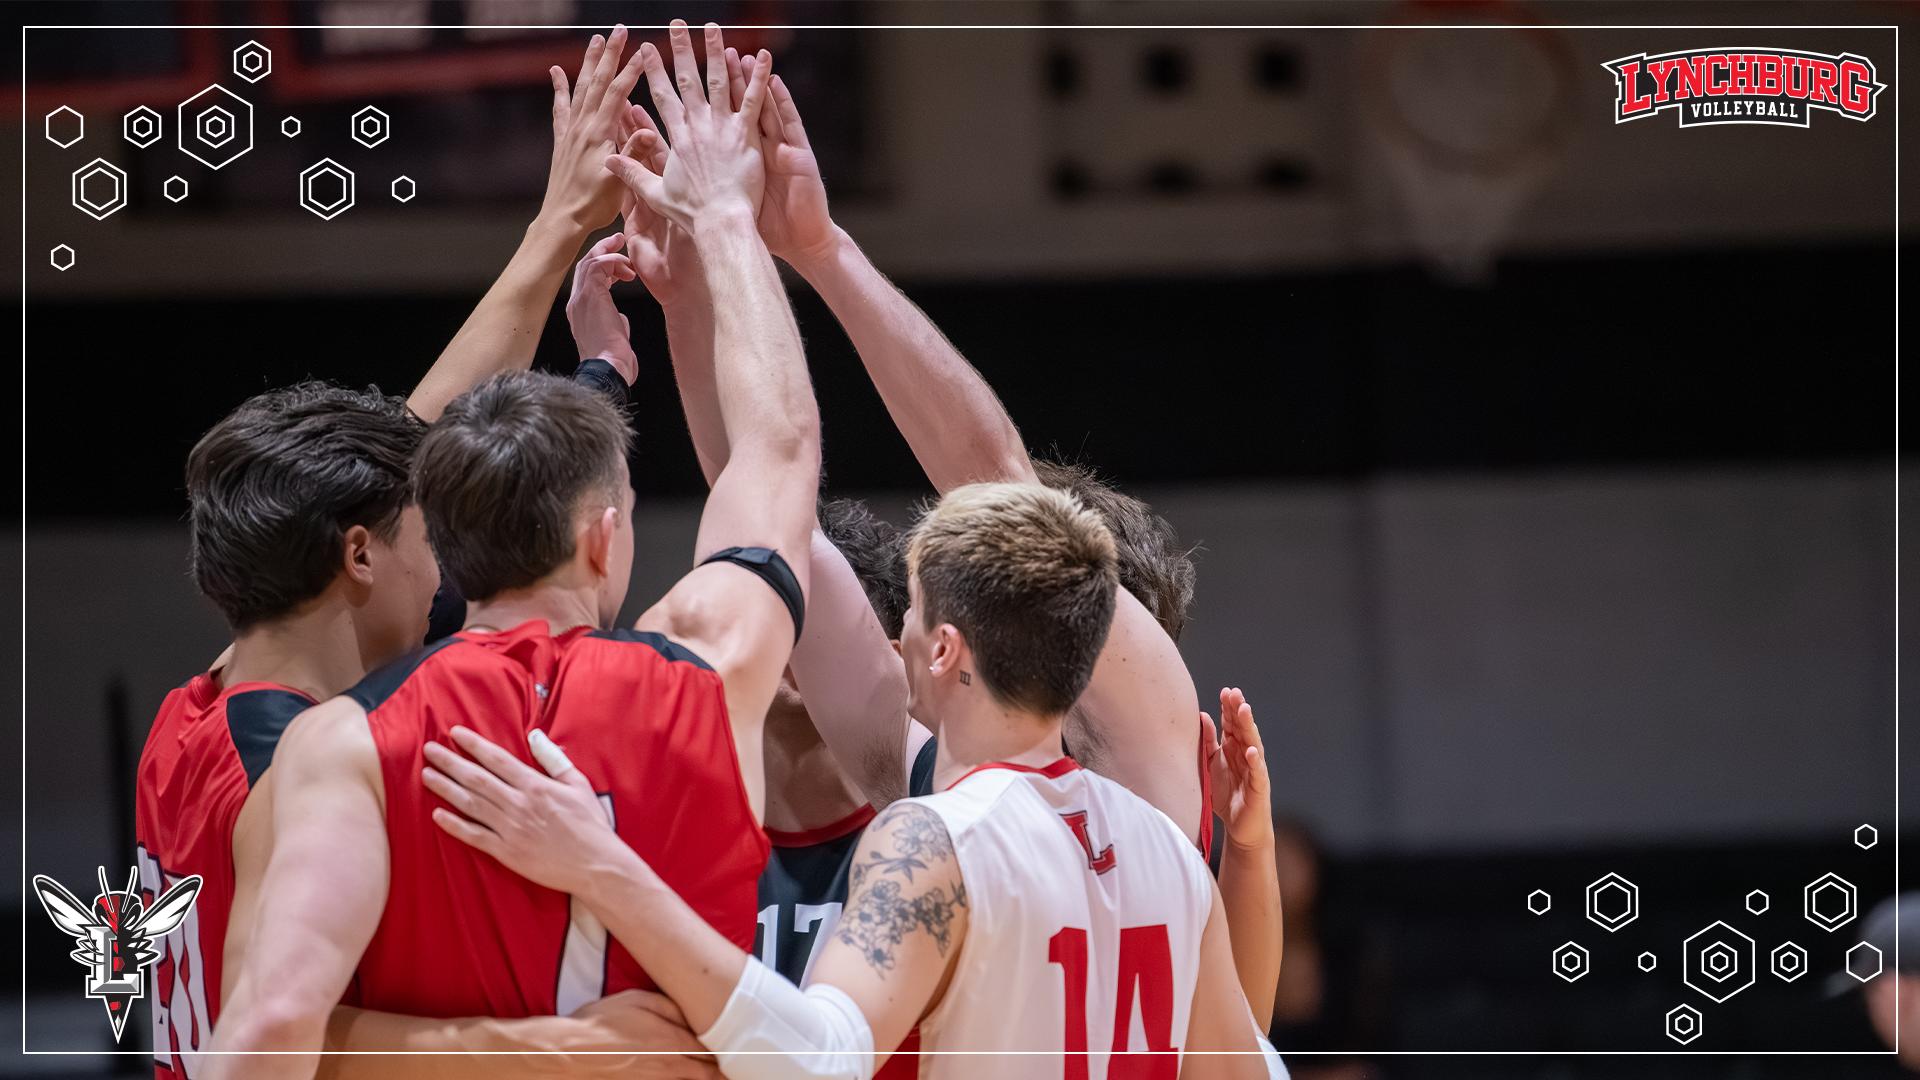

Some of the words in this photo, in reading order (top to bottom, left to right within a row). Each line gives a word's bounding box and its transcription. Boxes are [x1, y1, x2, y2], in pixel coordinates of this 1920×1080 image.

[1058, 809, 1117, 876] L
[756, 902, 843, 994] 17
[1048, 923, 1179, 1080] 14
